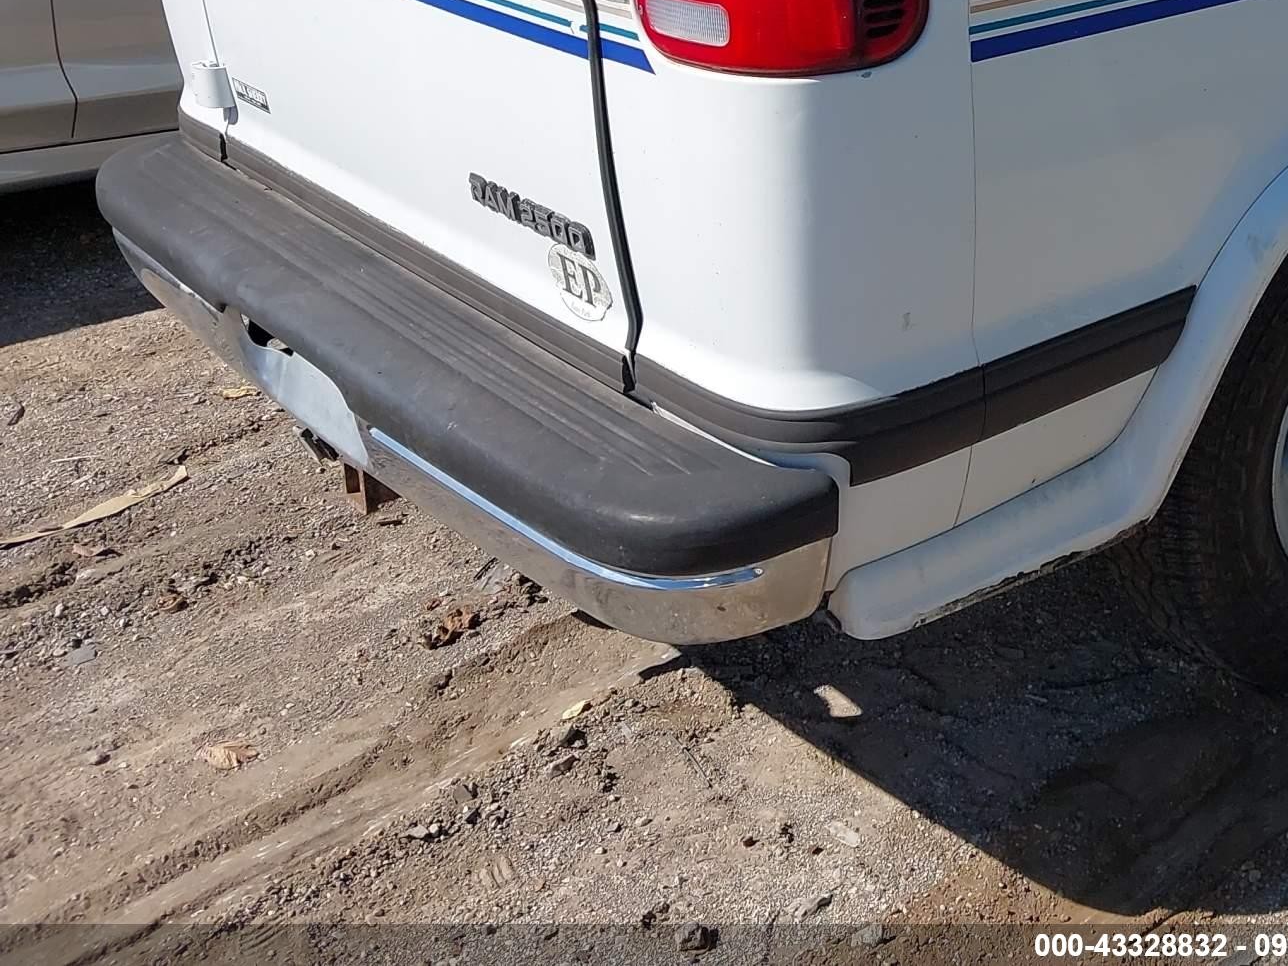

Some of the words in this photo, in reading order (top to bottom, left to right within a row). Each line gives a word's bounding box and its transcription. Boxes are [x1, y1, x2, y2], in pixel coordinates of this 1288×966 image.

[469, 172, 520, 223] RAM
[519, 197, 597, 261] 2500
[556, 251, 602, 308] EP
